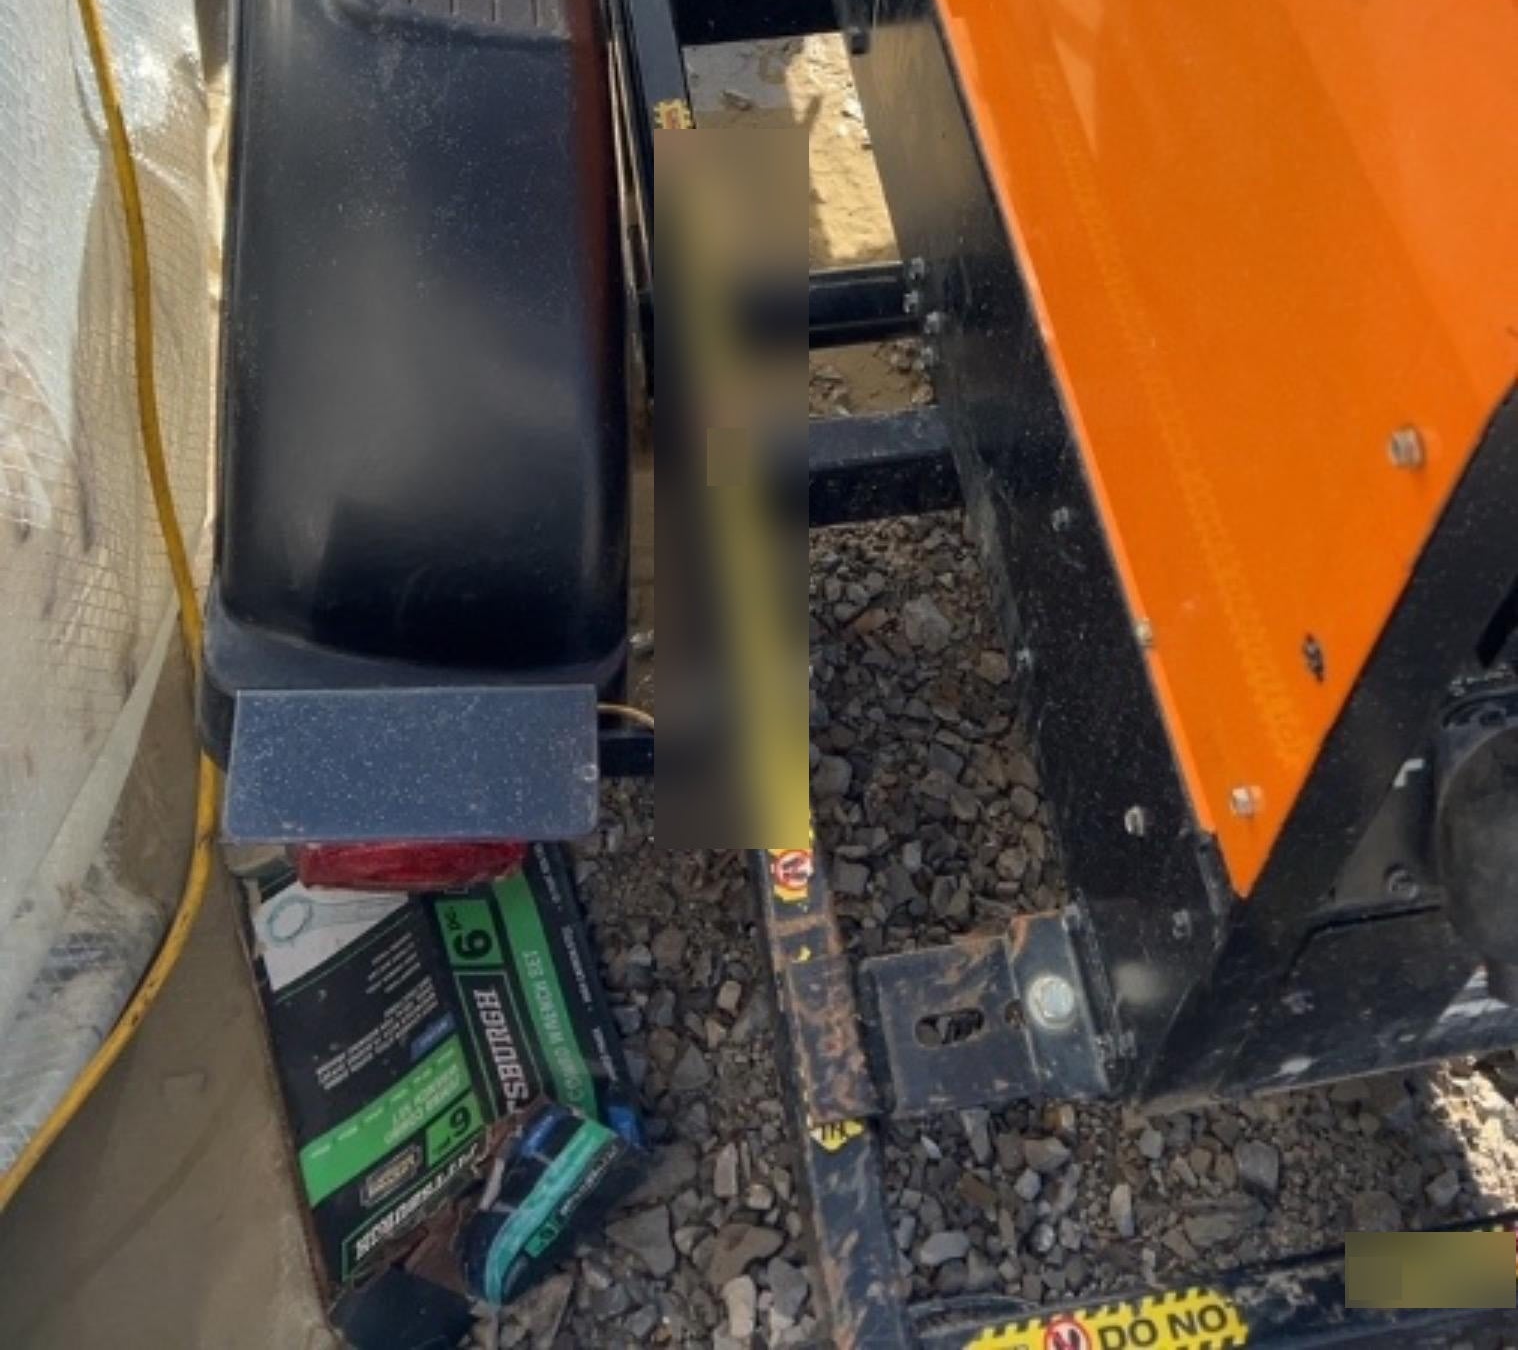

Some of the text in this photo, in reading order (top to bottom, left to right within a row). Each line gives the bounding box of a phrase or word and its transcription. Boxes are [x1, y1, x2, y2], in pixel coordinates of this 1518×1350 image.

[453, 929, 493, 961] 6
[521, 950, 545, 979] SET
[533, 979, 565, 1045] WRENCH
[473, 985, 529, 1117] TSBURGH
[449, 1105, 472, 1138] 6
[1097, 1301, 1232, 1350] DO NO
